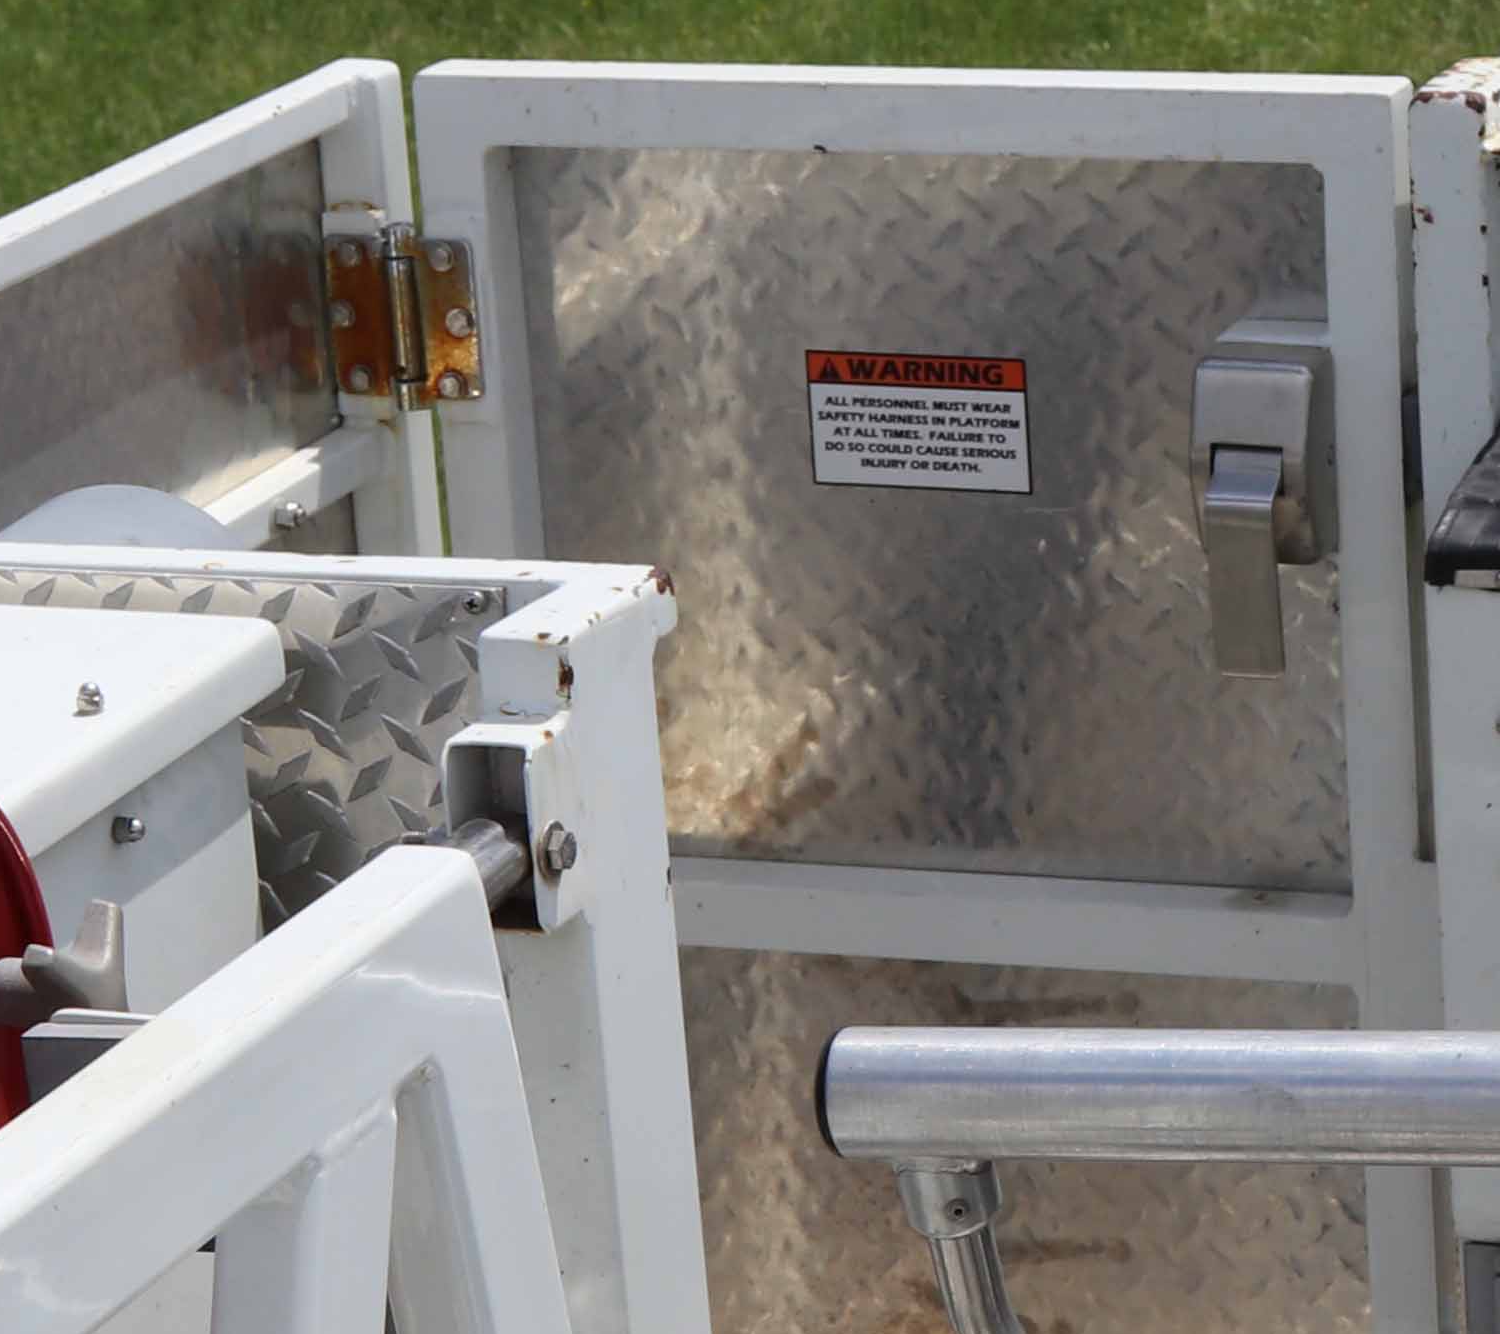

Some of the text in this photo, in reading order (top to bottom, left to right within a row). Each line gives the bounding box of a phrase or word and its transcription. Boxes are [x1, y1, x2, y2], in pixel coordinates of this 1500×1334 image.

[846, 358, 1004, 385] WARNING
[825, 396, 1011, 414] ALL PERSONNEL MUST WEAR
[818, 411, 1020, 430] SAFETY HARNESS IN PLATFORM
[834, 427, 1006, 444] AT ALL TIMES. FAILURE TO
[824, 441, 1017, 460] DO SO COULD CAUSE SERIOUS
[861, 458, 981, 474] INJURY OR DEATH.
